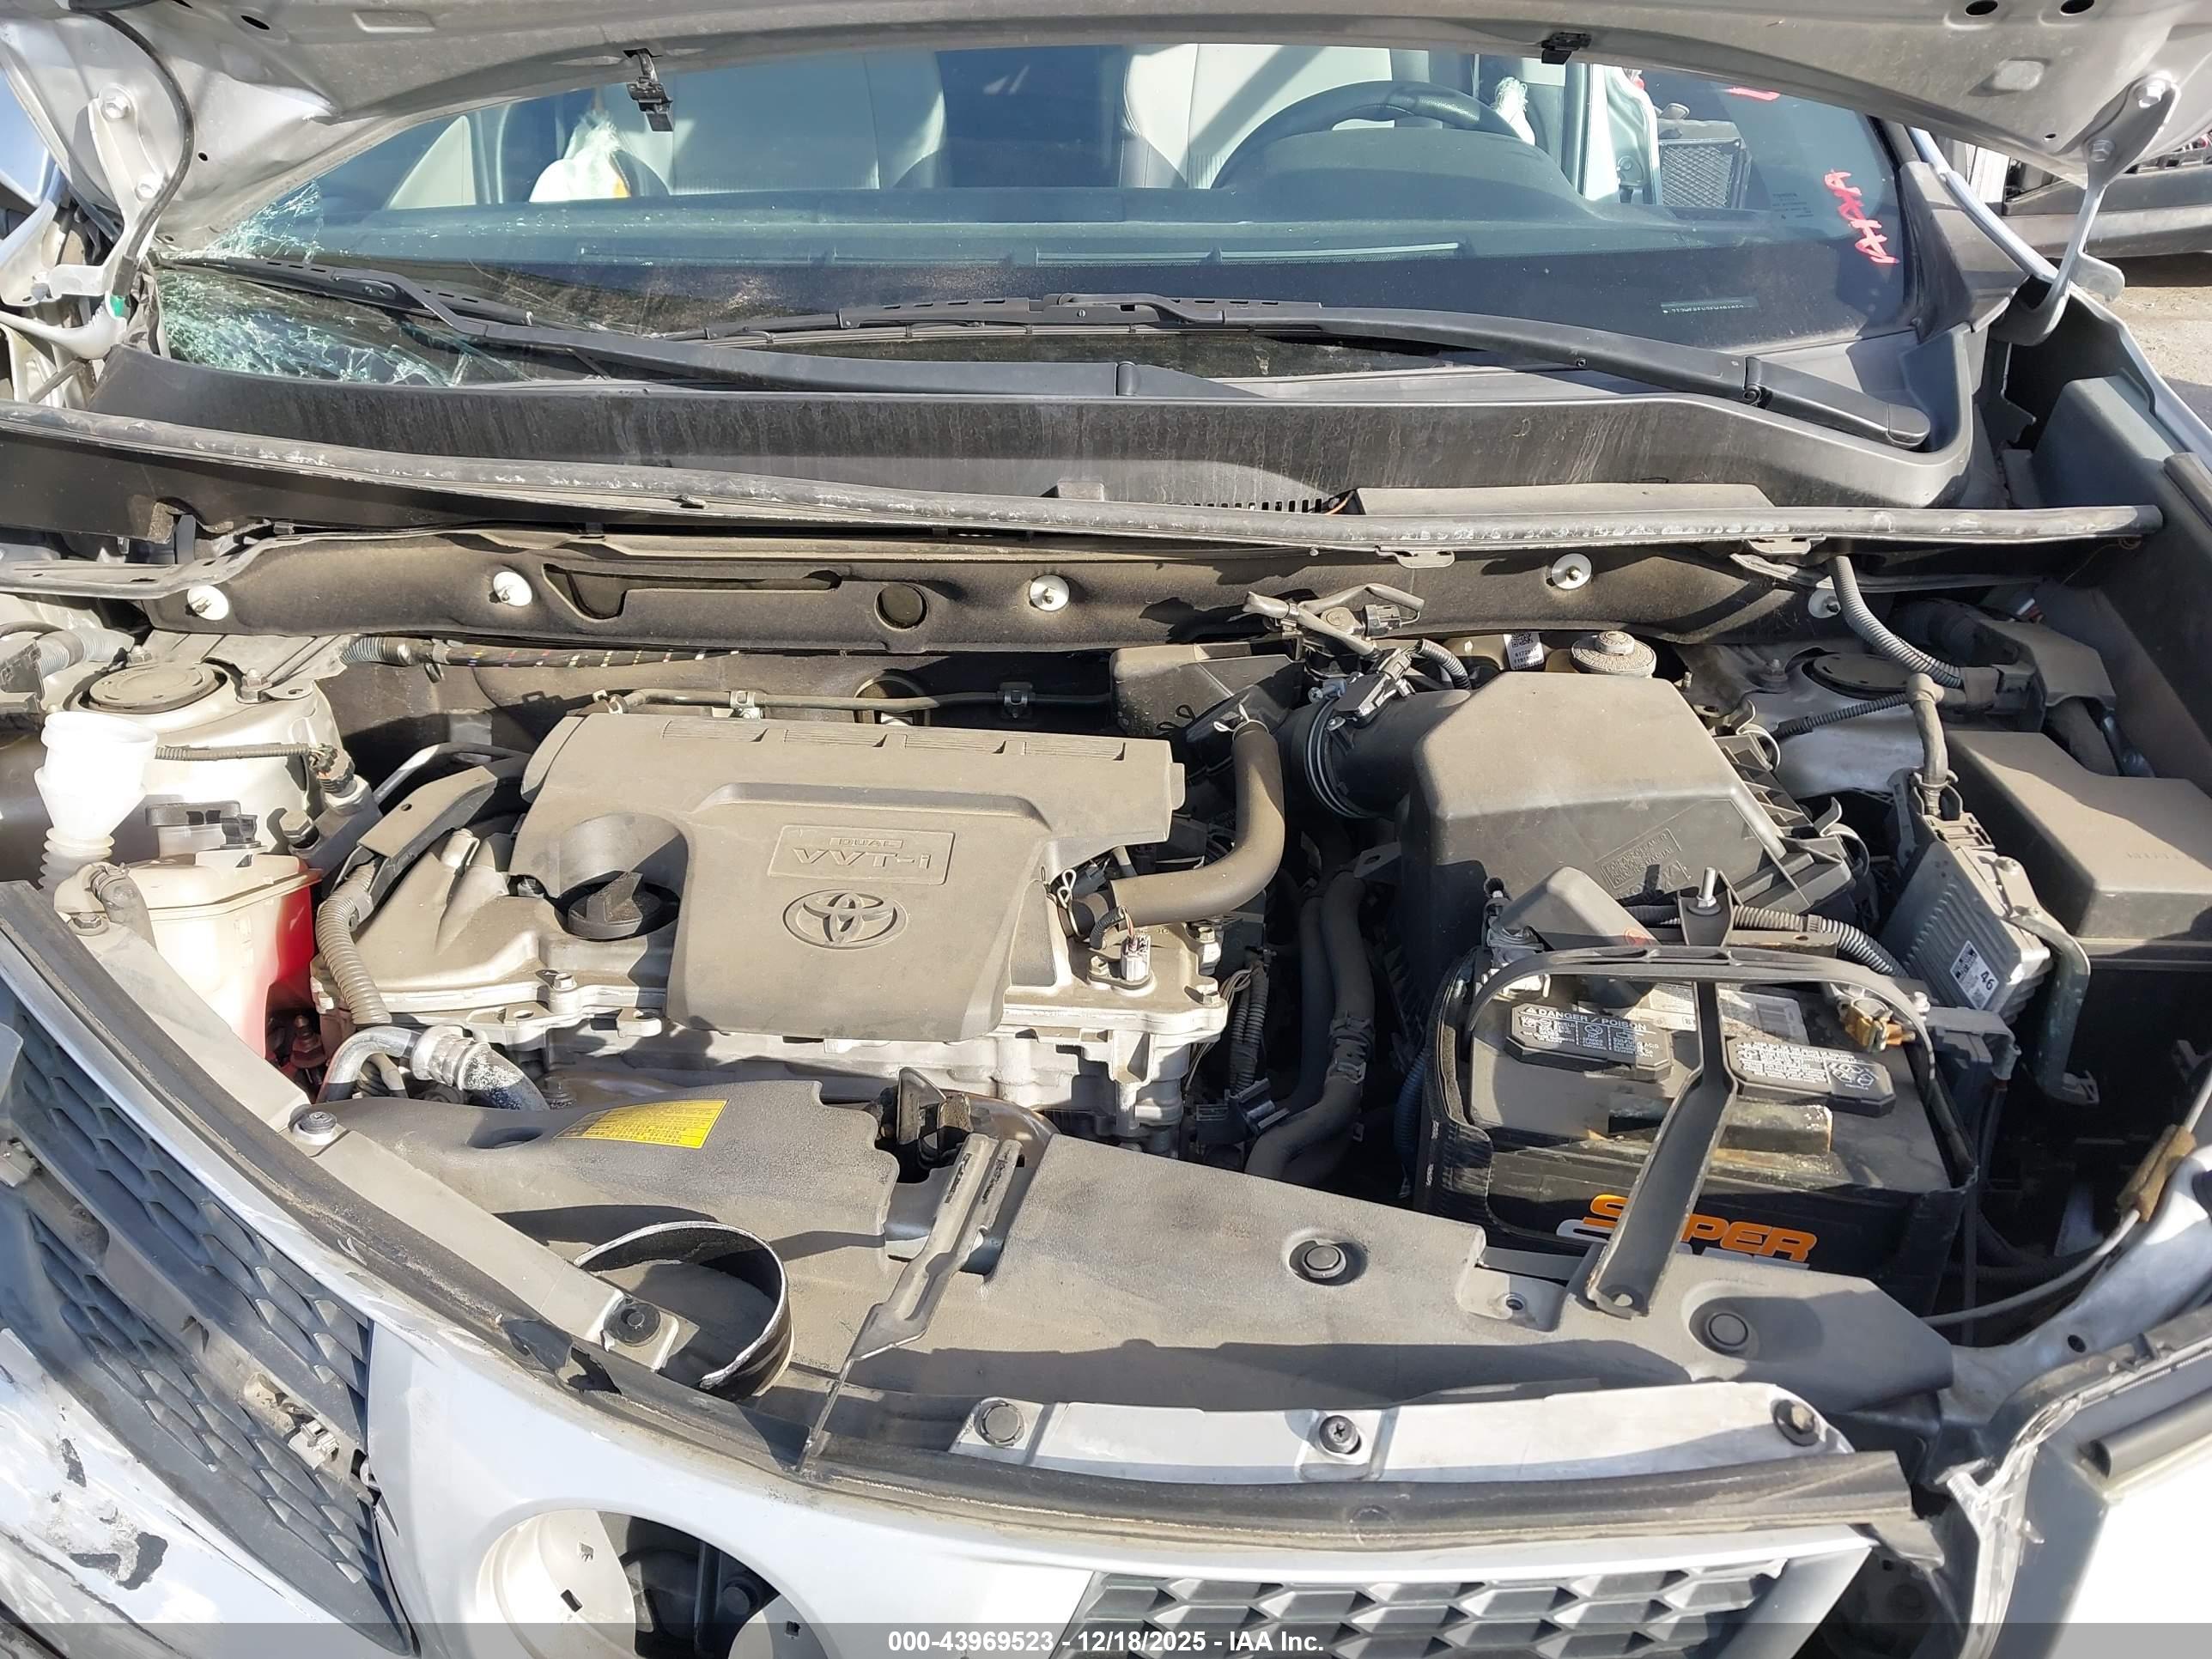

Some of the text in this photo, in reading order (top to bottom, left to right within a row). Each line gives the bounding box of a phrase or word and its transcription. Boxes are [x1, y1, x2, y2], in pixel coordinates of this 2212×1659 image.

[793, 848, 932, 870] VVT-i
[1980, 970, 1995, 991] 46
[1538, 1008, 1589, 1023] DANGER
[1601, 1018, 1647, 1031] POISON
[1583, 1194, 1818, 1262] SPER
